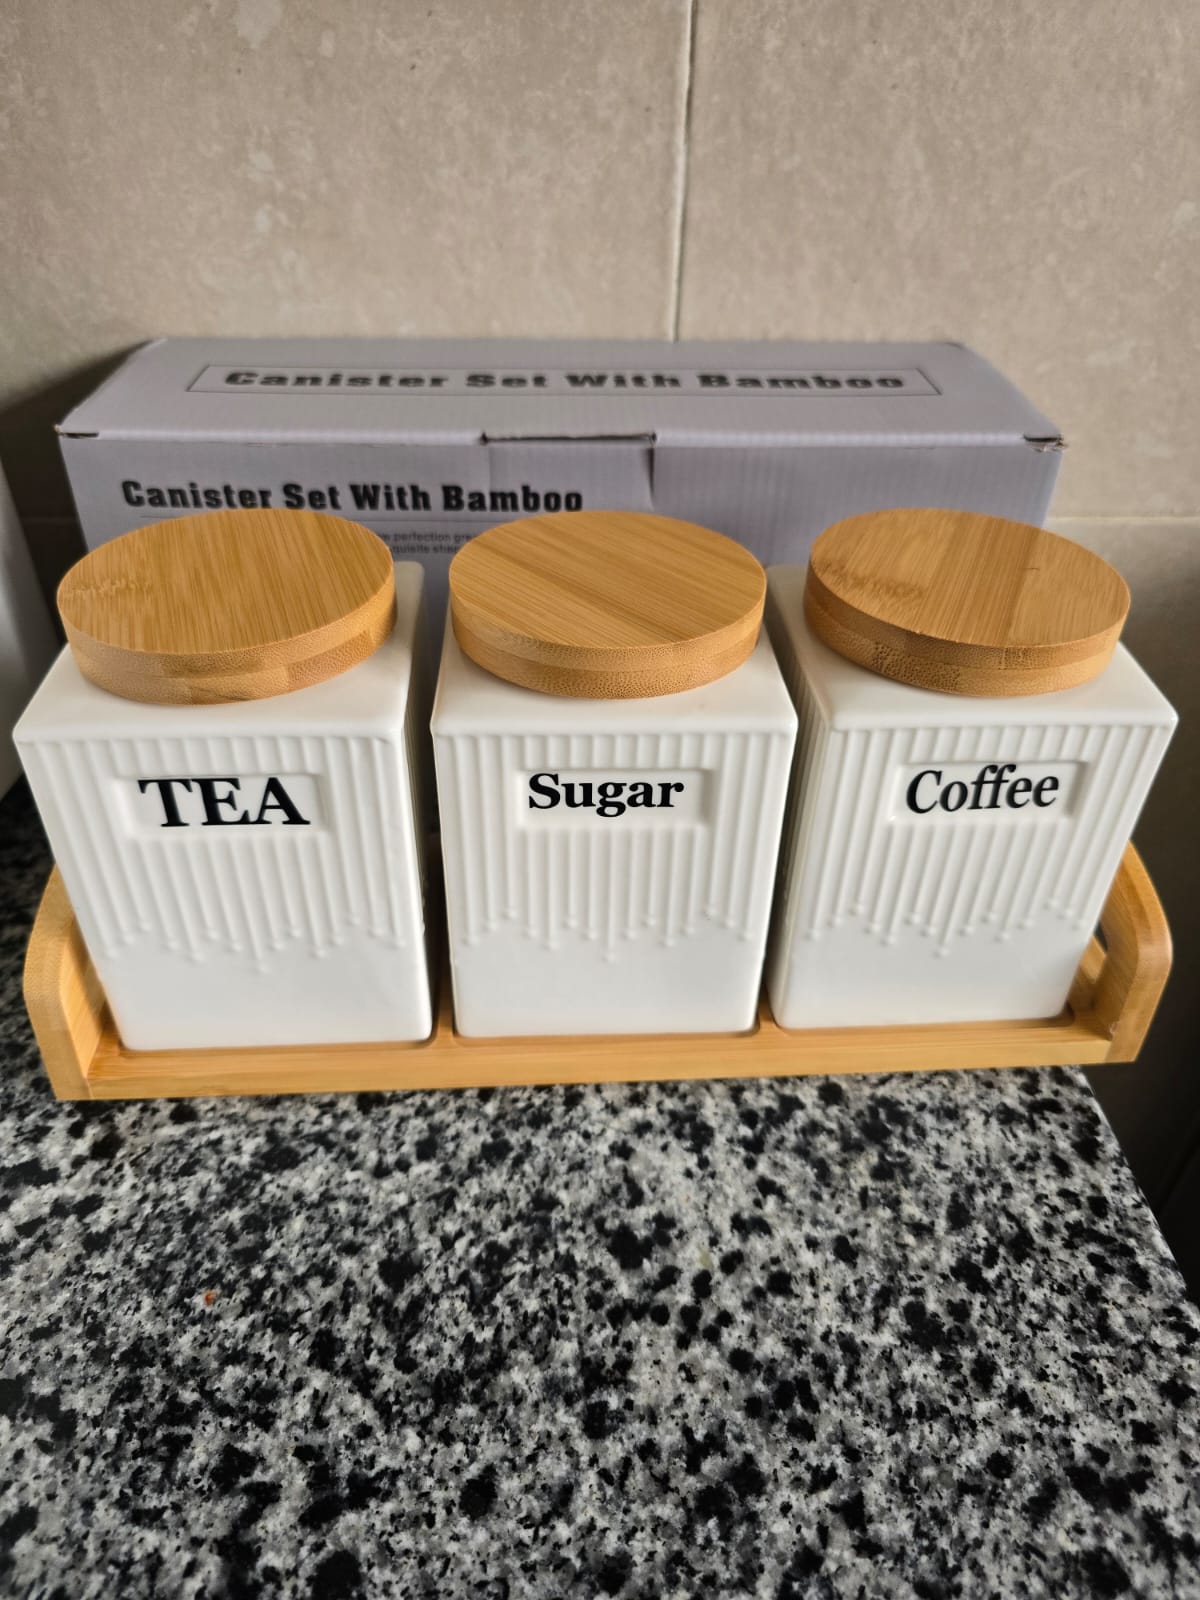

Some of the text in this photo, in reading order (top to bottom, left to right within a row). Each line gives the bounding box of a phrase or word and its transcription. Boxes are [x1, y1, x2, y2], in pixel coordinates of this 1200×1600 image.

[225, 371, 905, 389] Canister Set With Bamboo
[121, 479, 583, 512] Canister Set With Bamboo
[137, 777, 311, 827] TEA
[528, 772, 685, 818] Sugar
[906, 763, 1060, 814] Coffee
